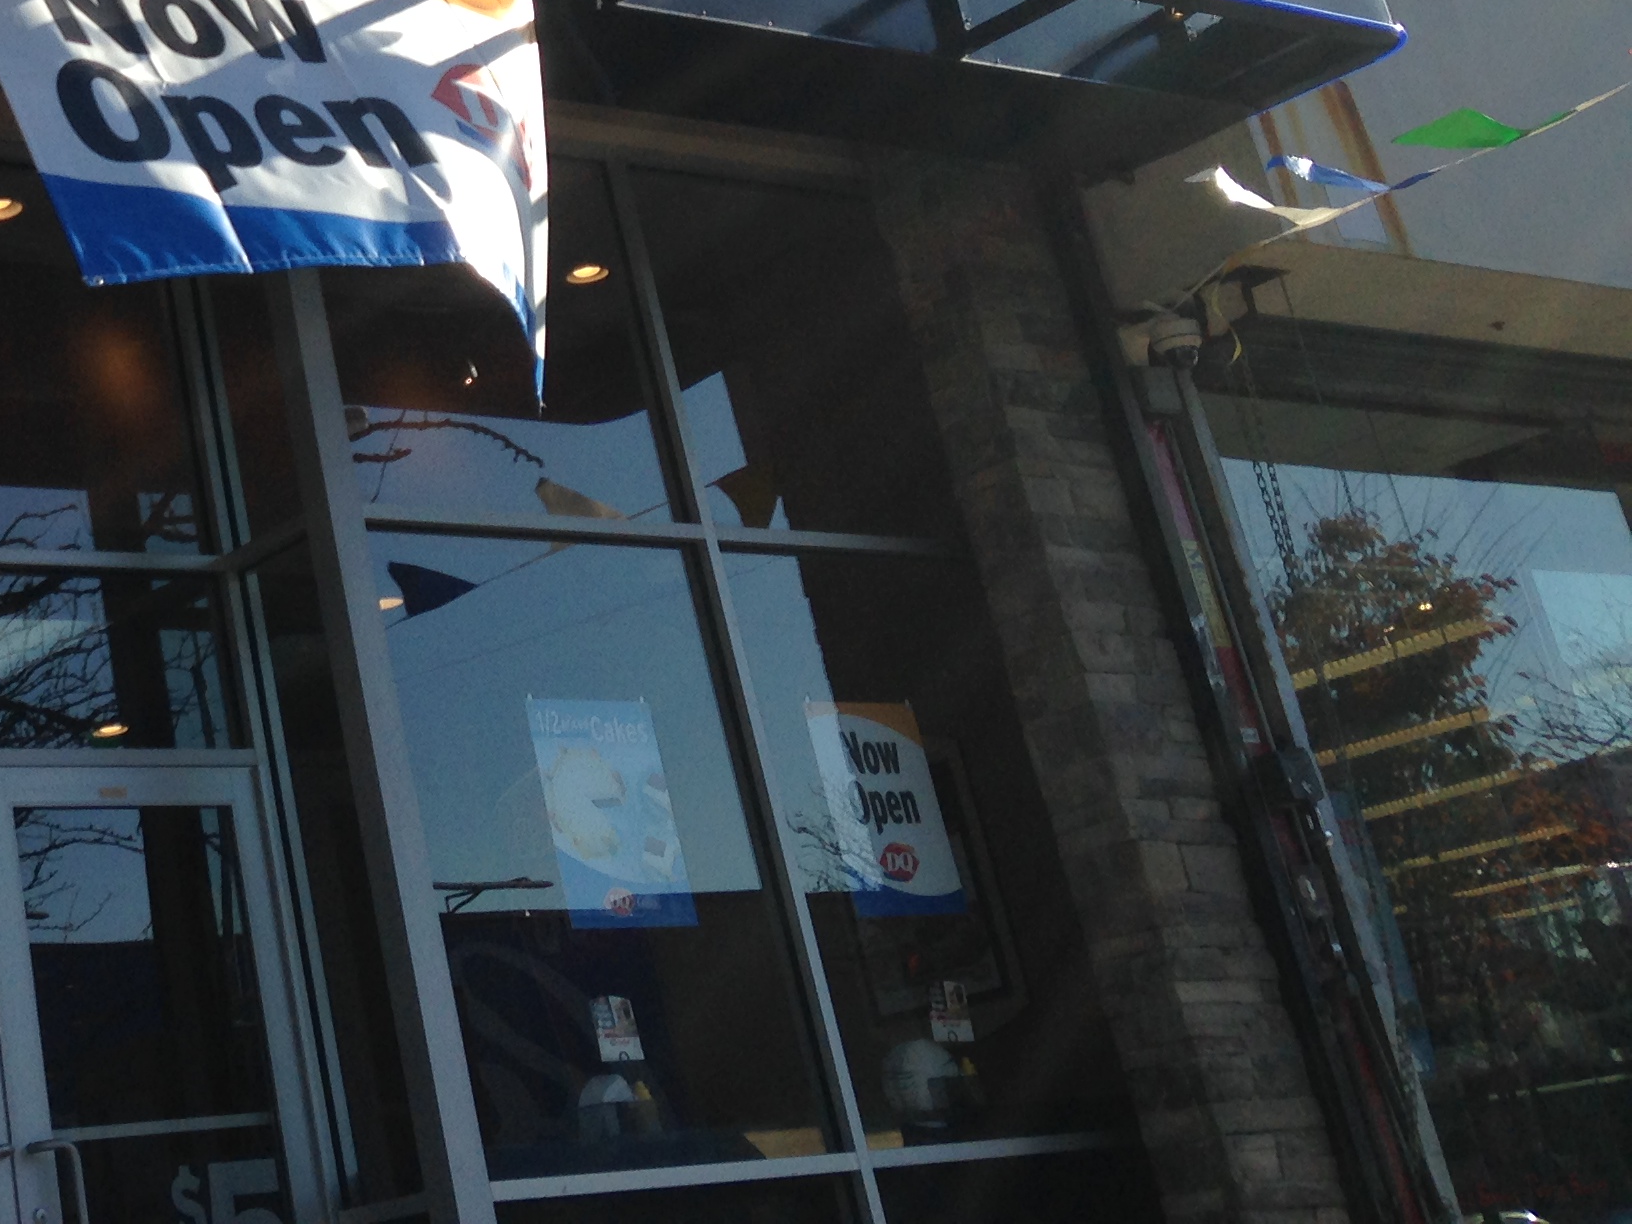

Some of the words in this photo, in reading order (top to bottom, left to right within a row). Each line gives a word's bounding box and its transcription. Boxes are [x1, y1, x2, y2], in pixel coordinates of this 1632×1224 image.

[56, 57, 442, 194] Open
[590, 715, 649, 744] Cakes
[839, 730, 901, 775] Now
[847, 779, 922, 836] Open
[885, 851, 914, 874] DQ
